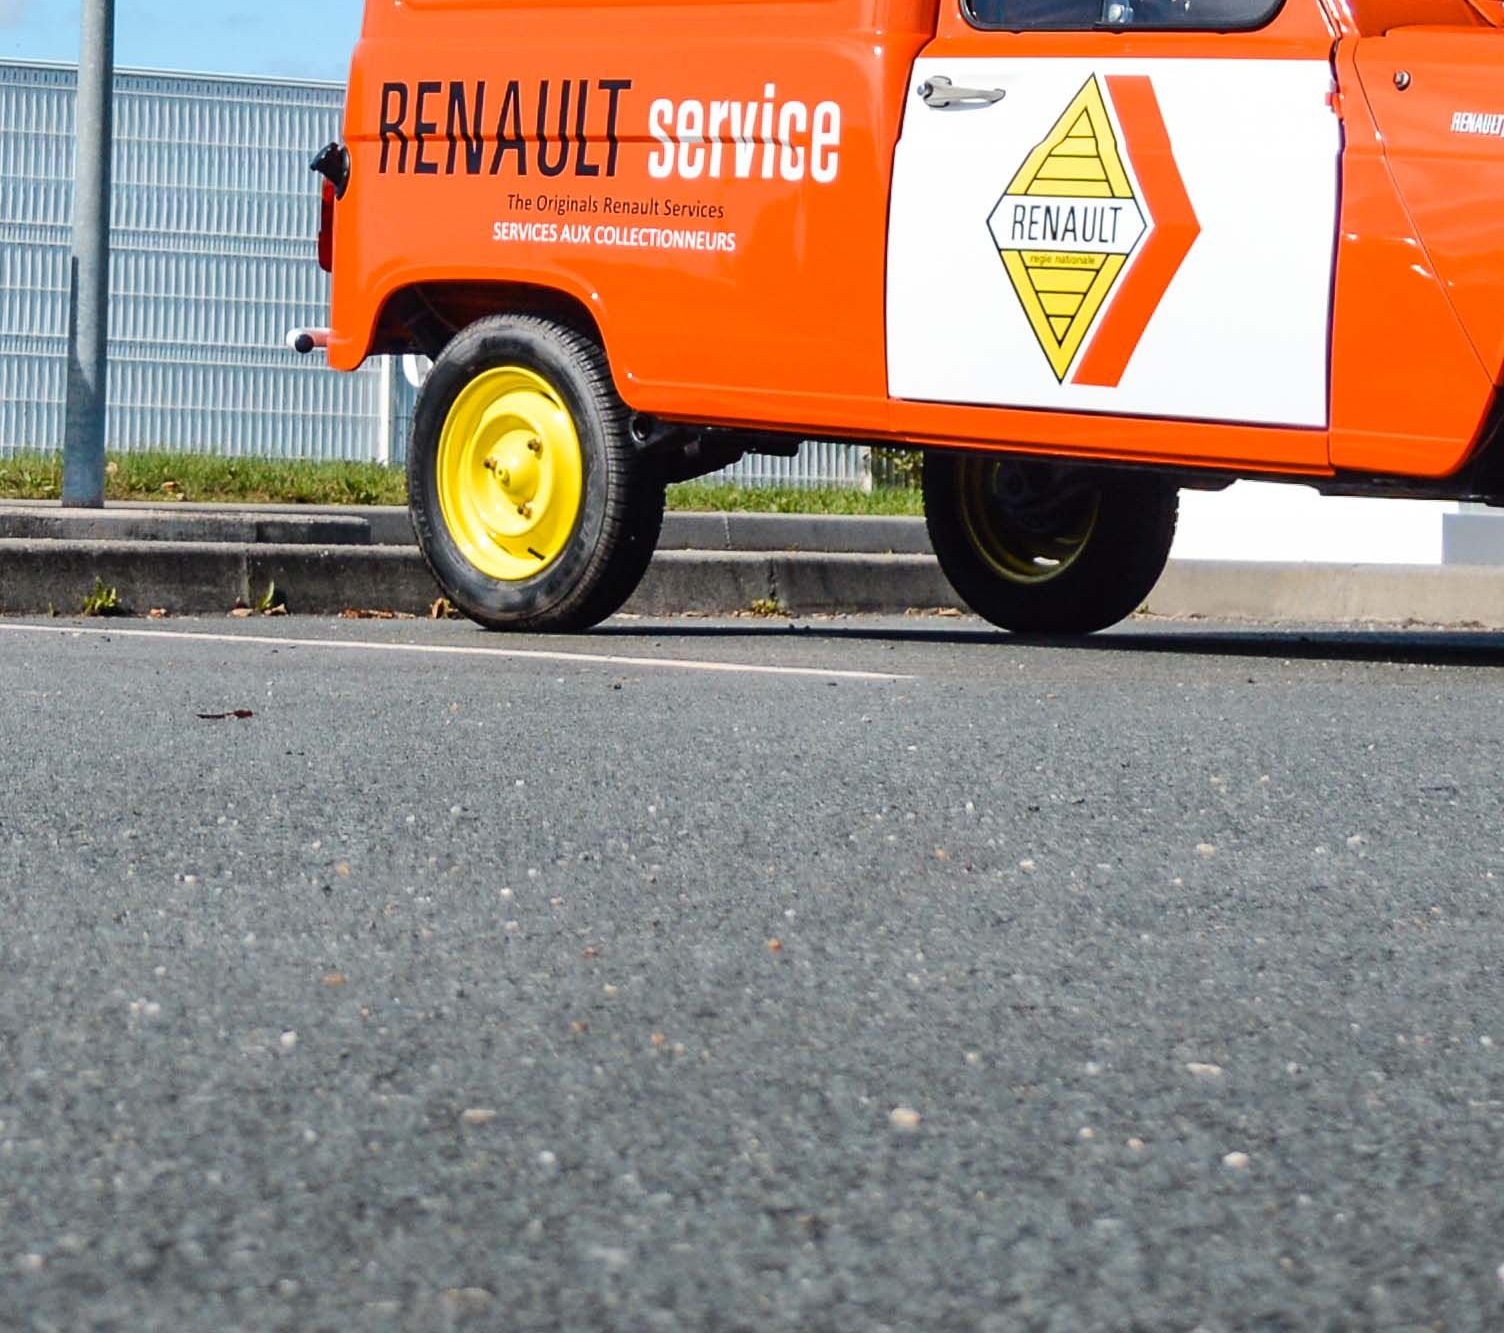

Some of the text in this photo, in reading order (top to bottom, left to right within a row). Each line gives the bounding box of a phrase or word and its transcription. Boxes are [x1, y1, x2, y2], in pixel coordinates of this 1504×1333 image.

[378, 79, 841, 183] RENAULT service
[1450, 110, 1504, 136] RENAULT
[507, 194, 725, 219] The Originals Renault Services
[493, 222, 737, 251] SERVICES AUX COLLECTIONNEURS
[1011, 204, 1123, 244] RENAULT
